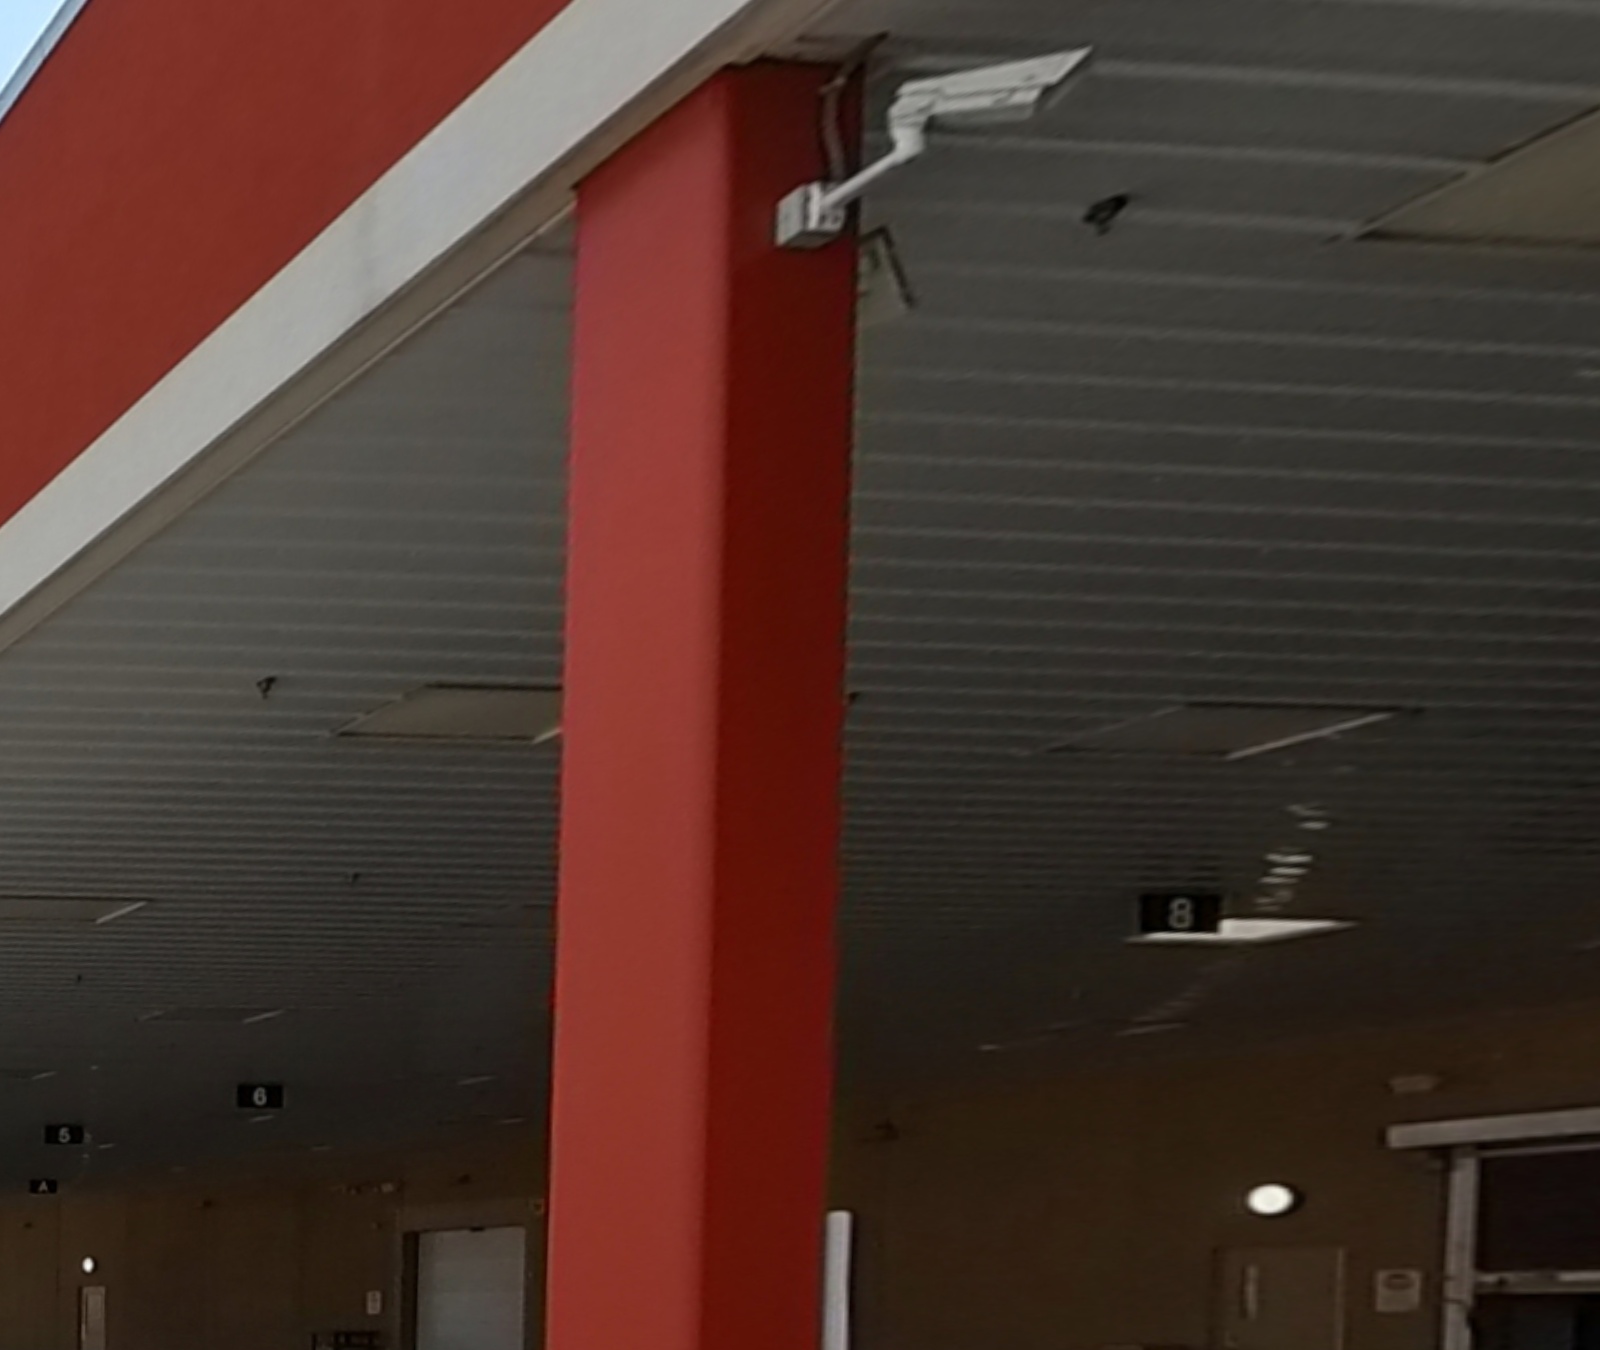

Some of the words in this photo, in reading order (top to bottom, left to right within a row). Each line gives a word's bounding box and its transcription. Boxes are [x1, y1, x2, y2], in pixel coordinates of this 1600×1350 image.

[1168, 898, 1194, 929] 8
[252, 1086, 267, 1106] 6
[57, 1127, 71, 1143] 5
[38, 1180, 48, 1192] A
